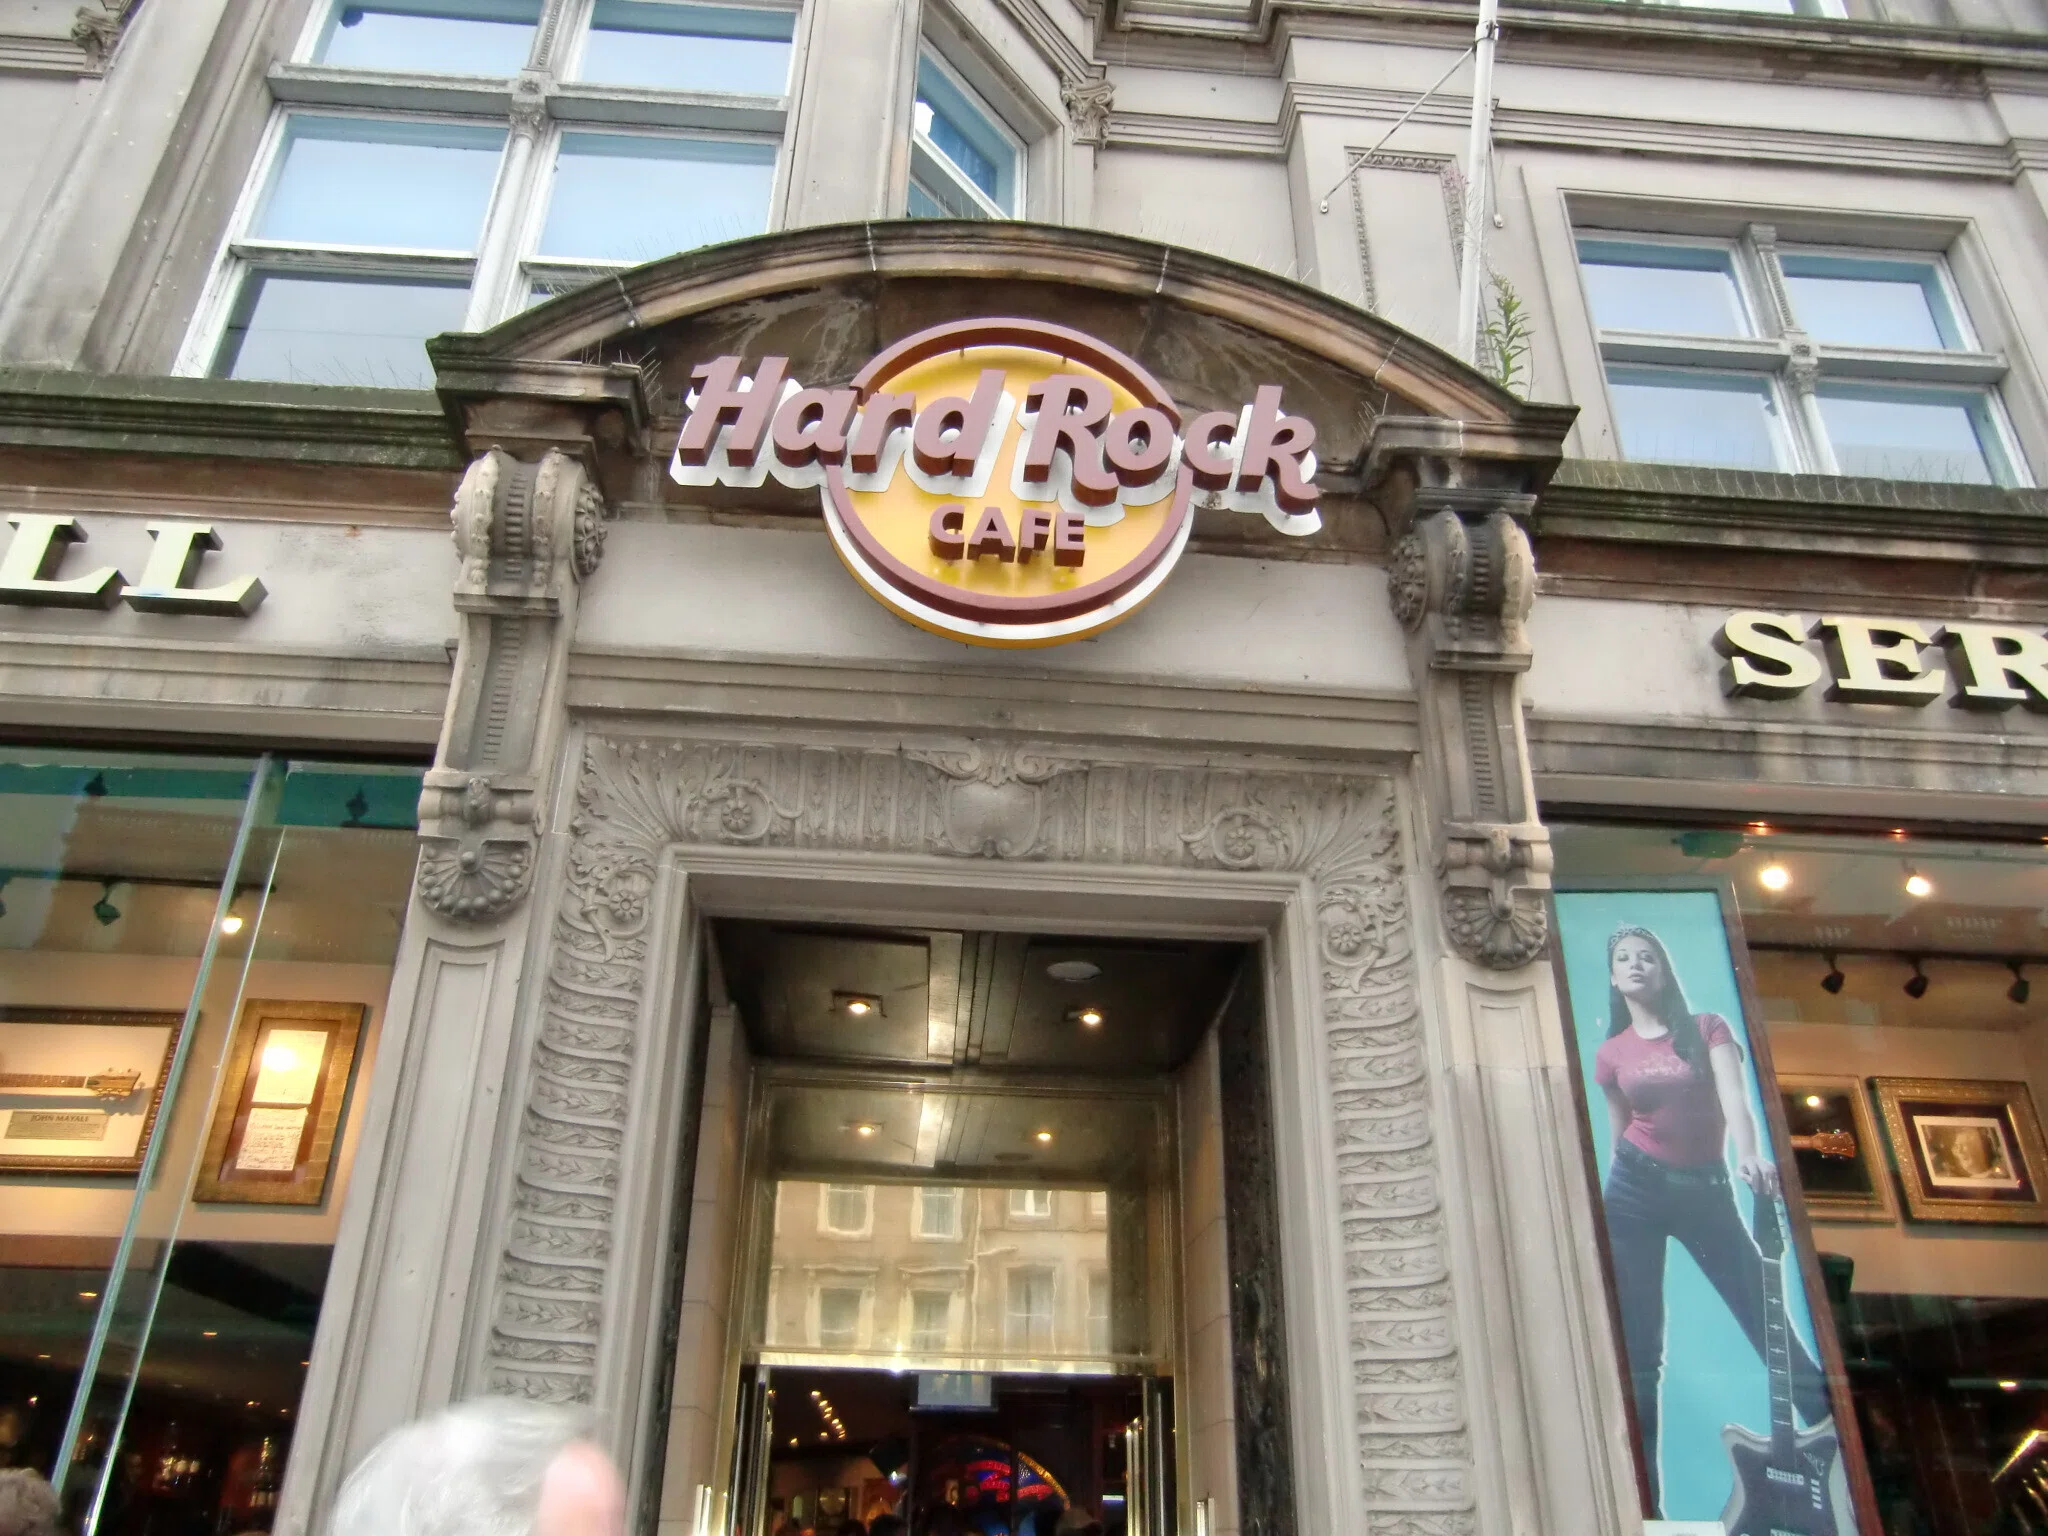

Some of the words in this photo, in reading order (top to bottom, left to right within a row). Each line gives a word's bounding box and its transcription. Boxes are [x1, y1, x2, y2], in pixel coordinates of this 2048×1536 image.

[677, 355, 1008, 476] Hard
[1023, 373, 1319, 516] Rock
[929, 504, 1086, 568] CAFE
[31, 1114, 55, 1122] JOHN
